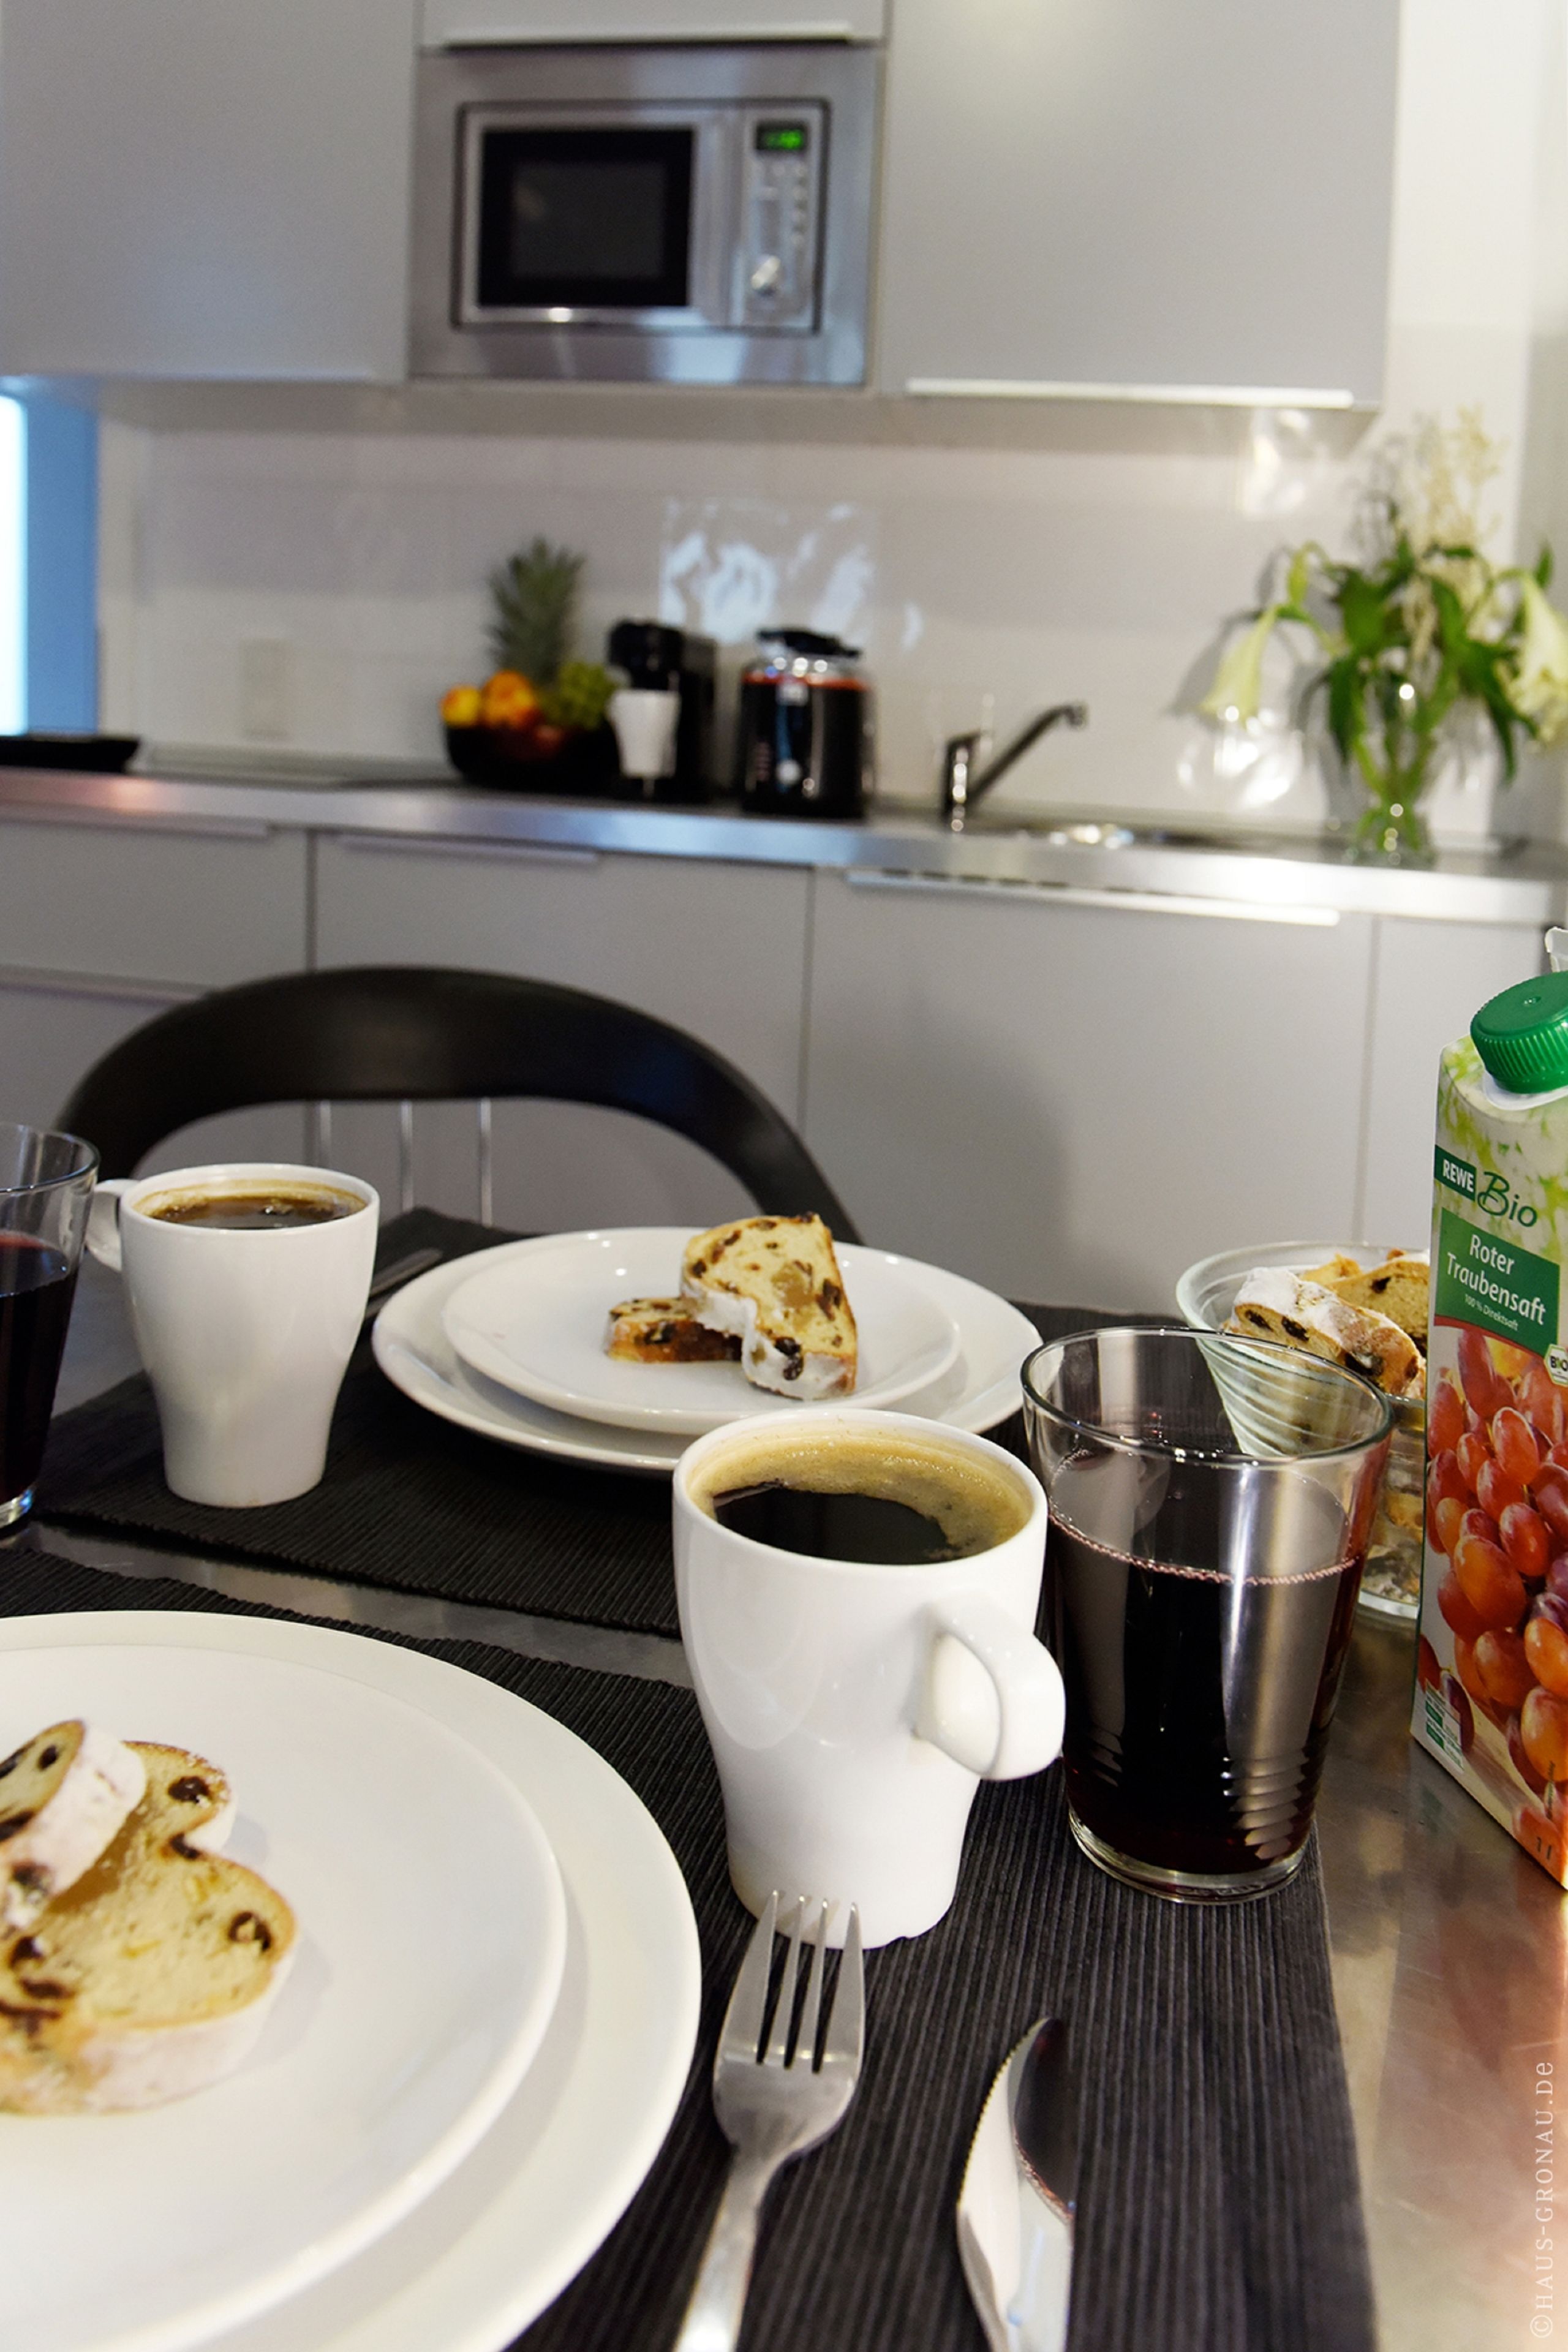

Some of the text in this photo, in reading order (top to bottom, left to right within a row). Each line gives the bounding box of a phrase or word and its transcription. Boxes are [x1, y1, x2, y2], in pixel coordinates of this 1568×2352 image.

[1442, 1159, 1537, 1227] REWE Bio
[1447, 1251, 1547, 1325] Traubensaft
[1469, 1234, 1515, 1275] Roter
